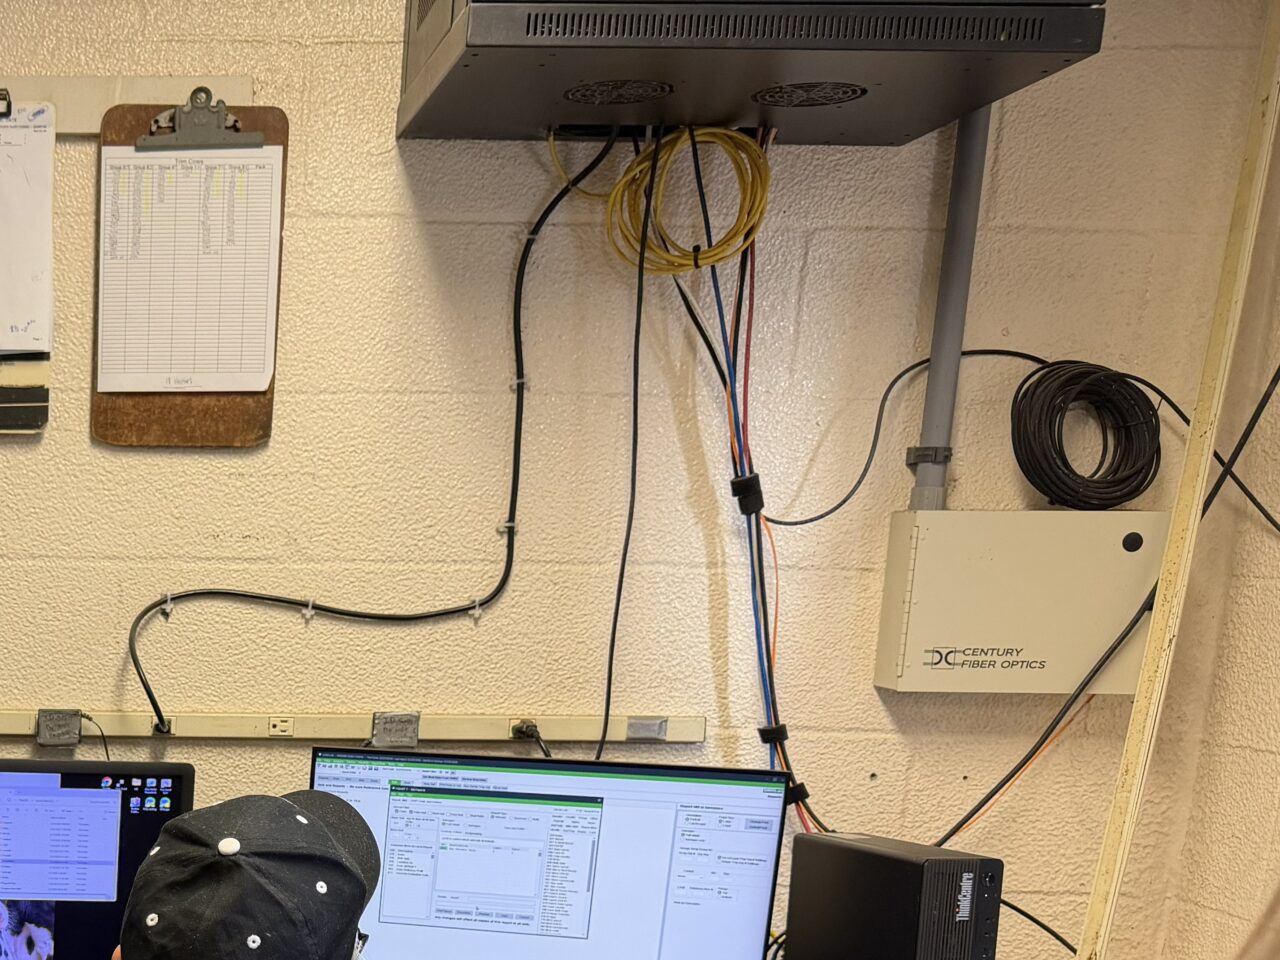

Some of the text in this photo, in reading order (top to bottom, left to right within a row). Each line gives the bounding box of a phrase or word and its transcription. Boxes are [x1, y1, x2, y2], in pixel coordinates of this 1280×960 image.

[962, 647, 1023, 657] CENTURY
[960, 659, 1047, 669] FIBER OPTICS
[955, 872, 974, 922] ThinkCentre
